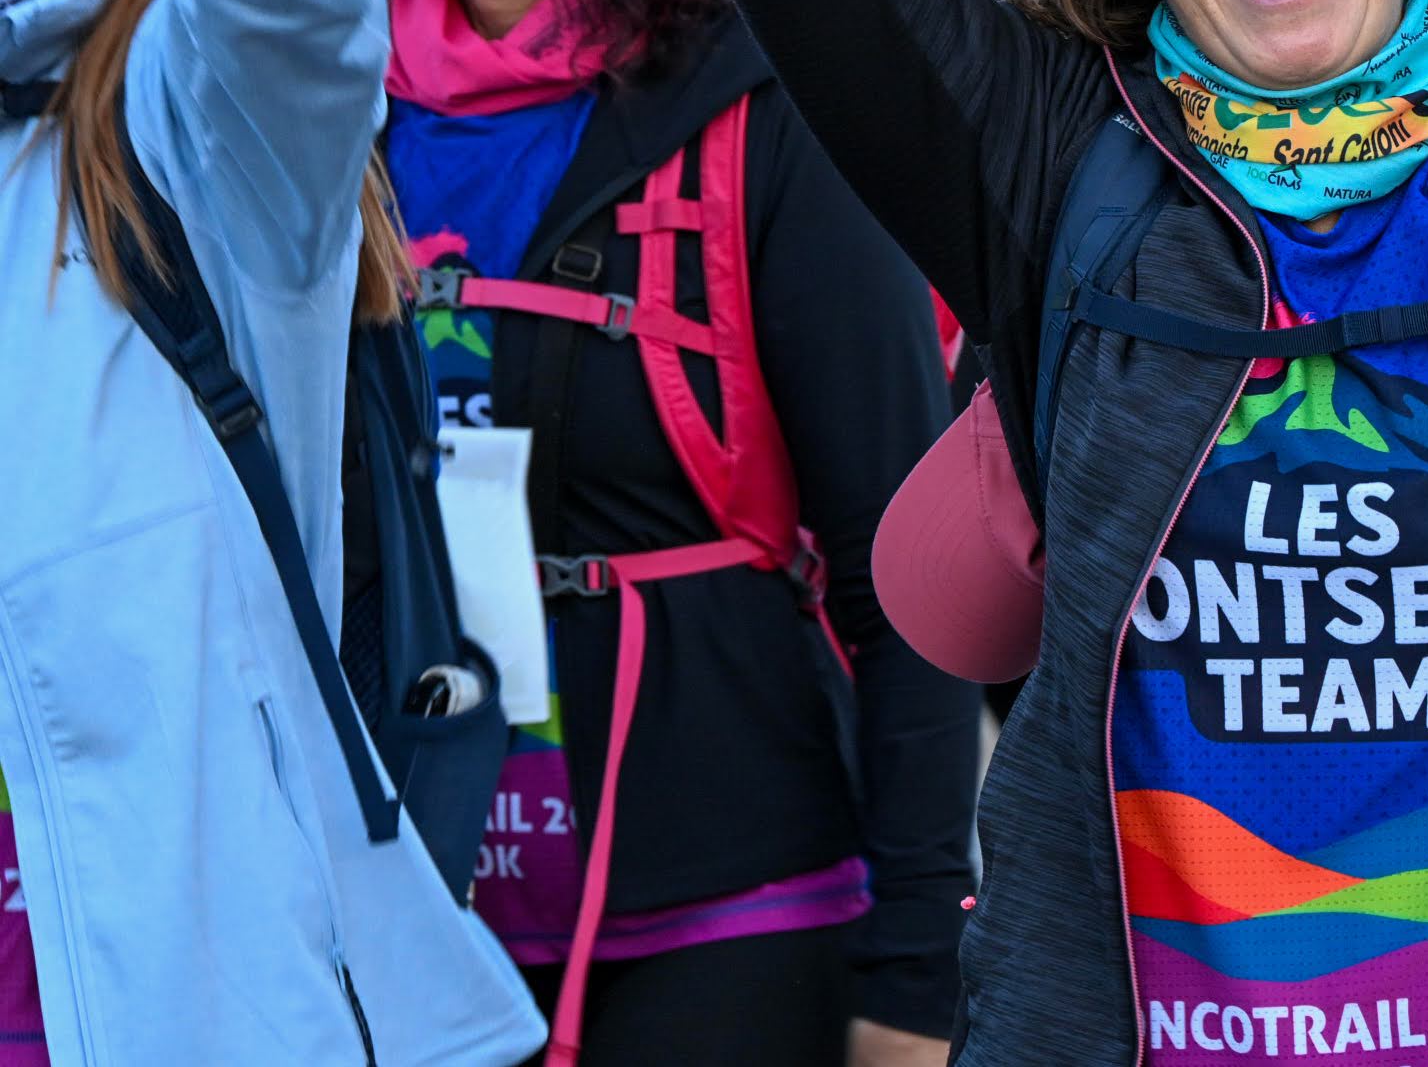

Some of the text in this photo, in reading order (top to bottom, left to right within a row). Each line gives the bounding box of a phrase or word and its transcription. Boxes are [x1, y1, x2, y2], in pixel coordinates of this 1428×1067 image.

[1273, 138, 1335, 165] Sant
[1339, 112, 1412, 163] Celoni
[1323, 186, 1373, 200] NATURA
[1243, 481, 1401, 557] LES
[1149, 998, 1426, 1057] NCOTRAIL
